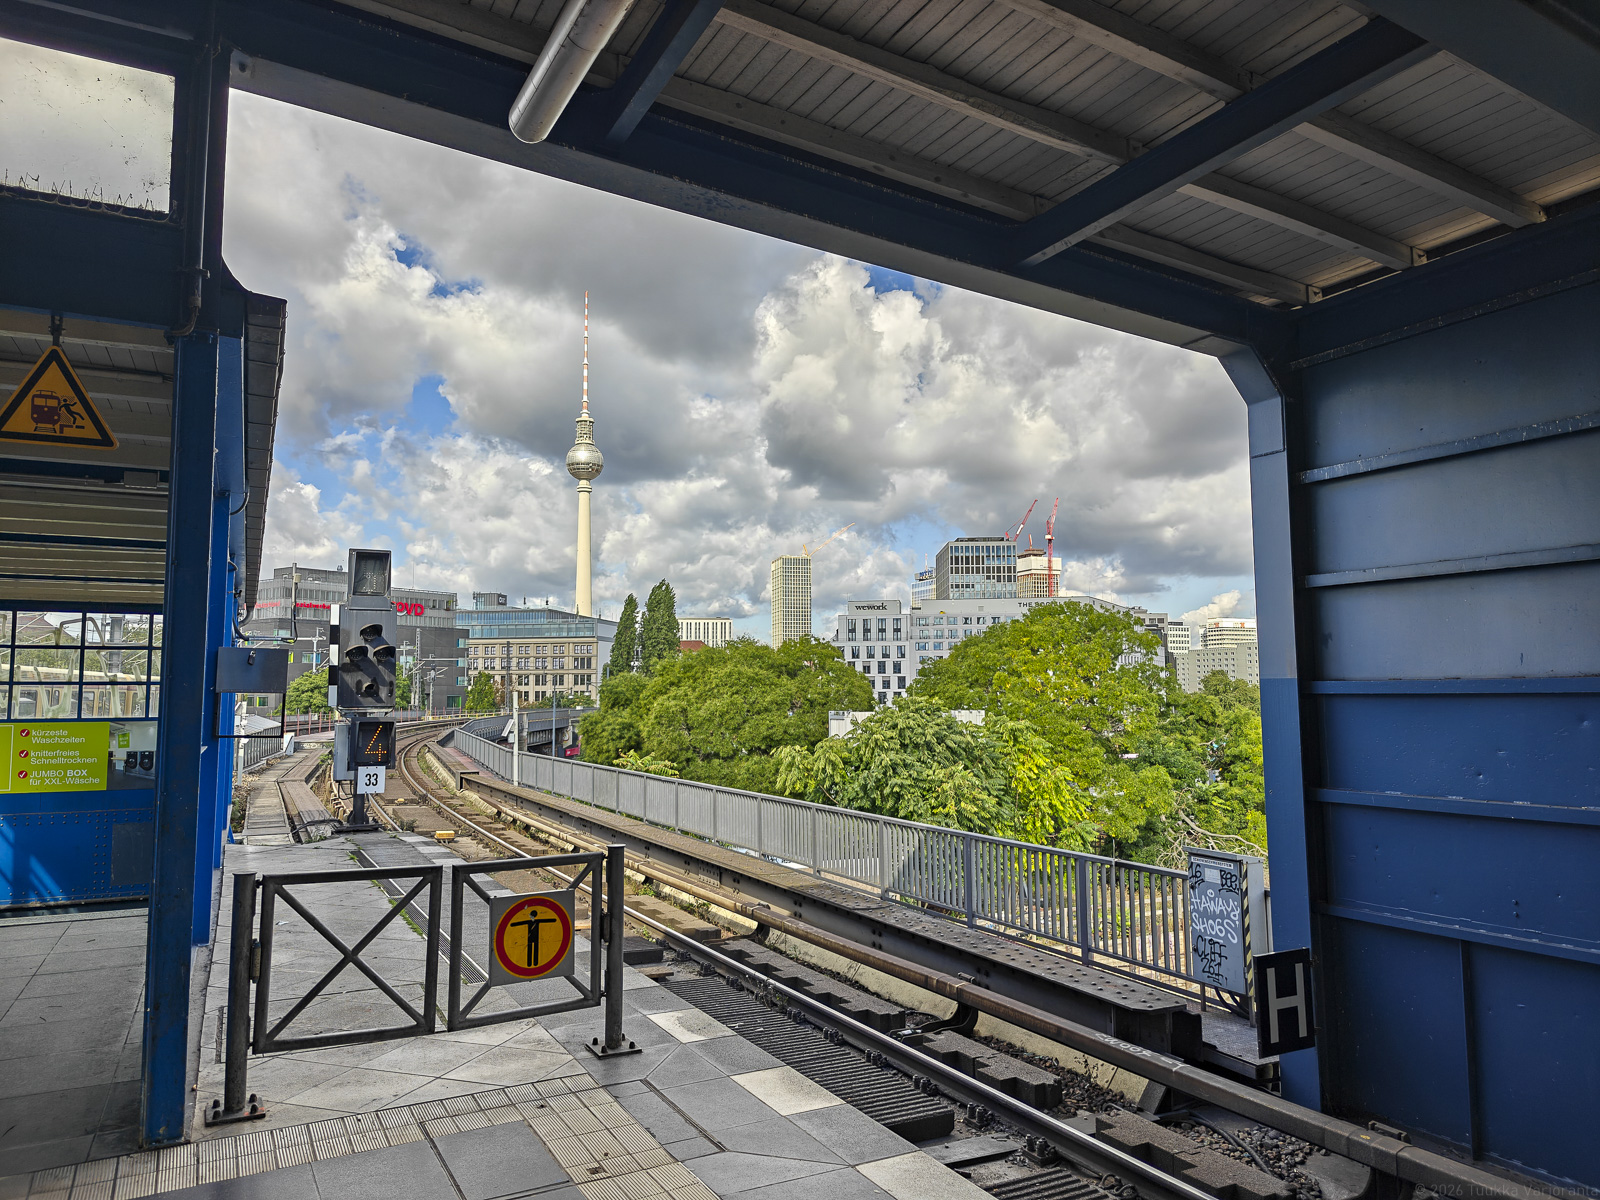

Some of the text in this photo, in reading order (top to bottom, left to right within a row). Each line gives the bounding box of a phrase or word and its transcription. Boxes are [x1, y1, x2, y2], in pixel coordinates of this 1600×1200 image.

[391, 601, 424, 616] oVD
[855, 602, 888, 611] wework
[365, 725, 387, 761] 4
[30, 749, 80, 757] knitterfreies
[30, 757, 98, 765] Schnelltrocknen
[67, 769, 88, 777] BOX
[29, 777, 100, 786] für XXL-Wäsche
[365, 773, 378, 787] 33
[1266, 962, 1308, 1044] H
